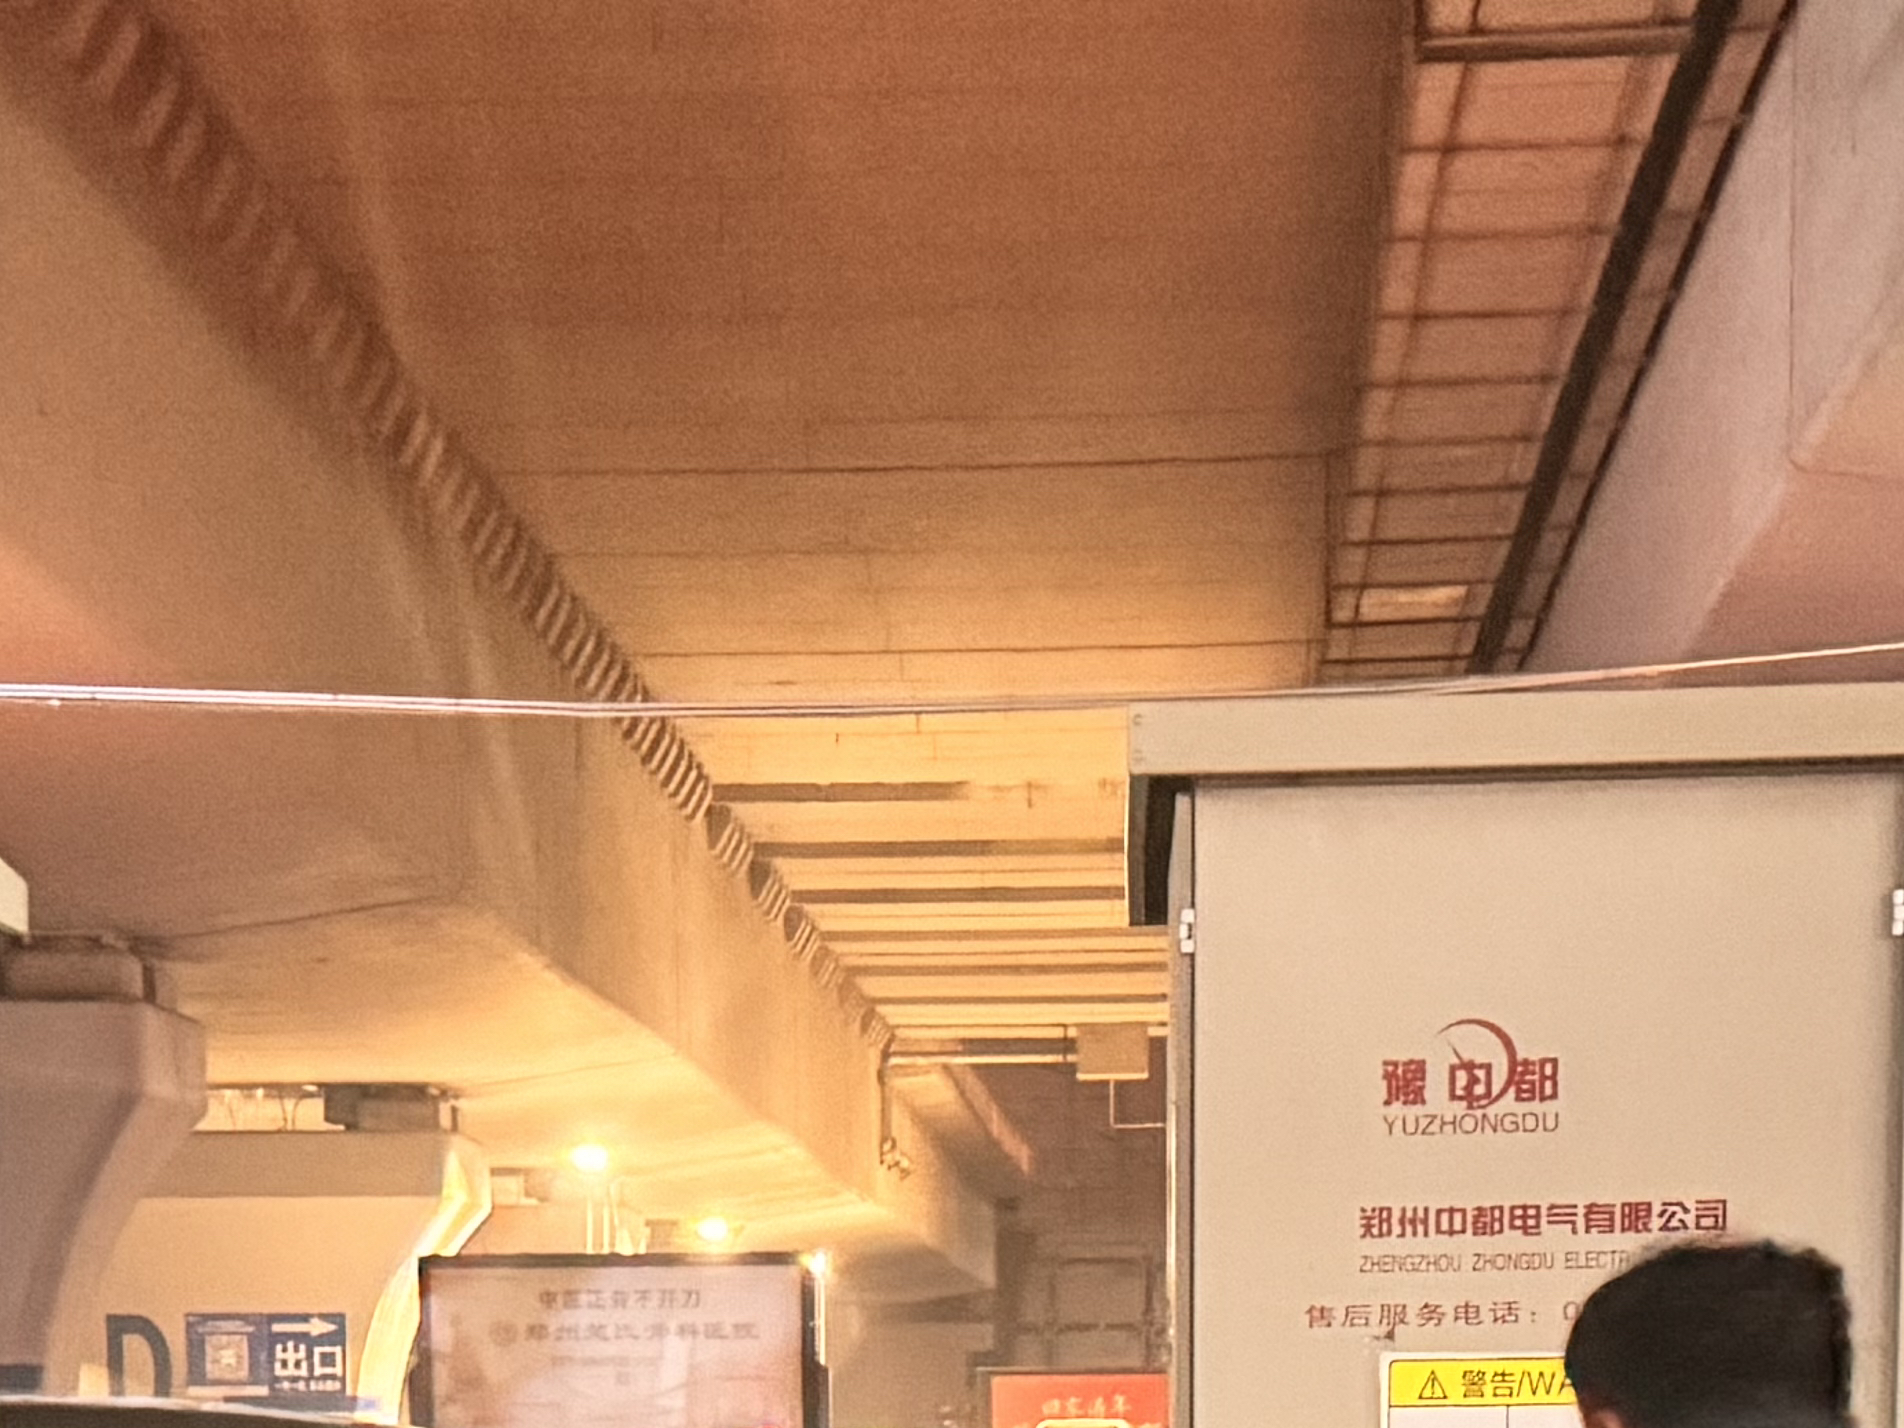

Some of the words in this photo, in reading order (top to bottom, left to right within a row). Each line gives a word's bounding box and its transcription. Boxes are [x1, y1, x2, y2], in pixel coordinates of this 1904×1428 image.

[1383, 1111, 1559, 1137] YUZHONGDU
[1359, 1198, 1729, 1240] 郑州中都电气有限公司
[1359, 1253, 1462, 1273] ZHENGZHOU
[1472, 1252, 1554, 1271] ZHONGDU
[106, 1313, 172, 1397] D
[274, 1340, 343, 1378] 出口
